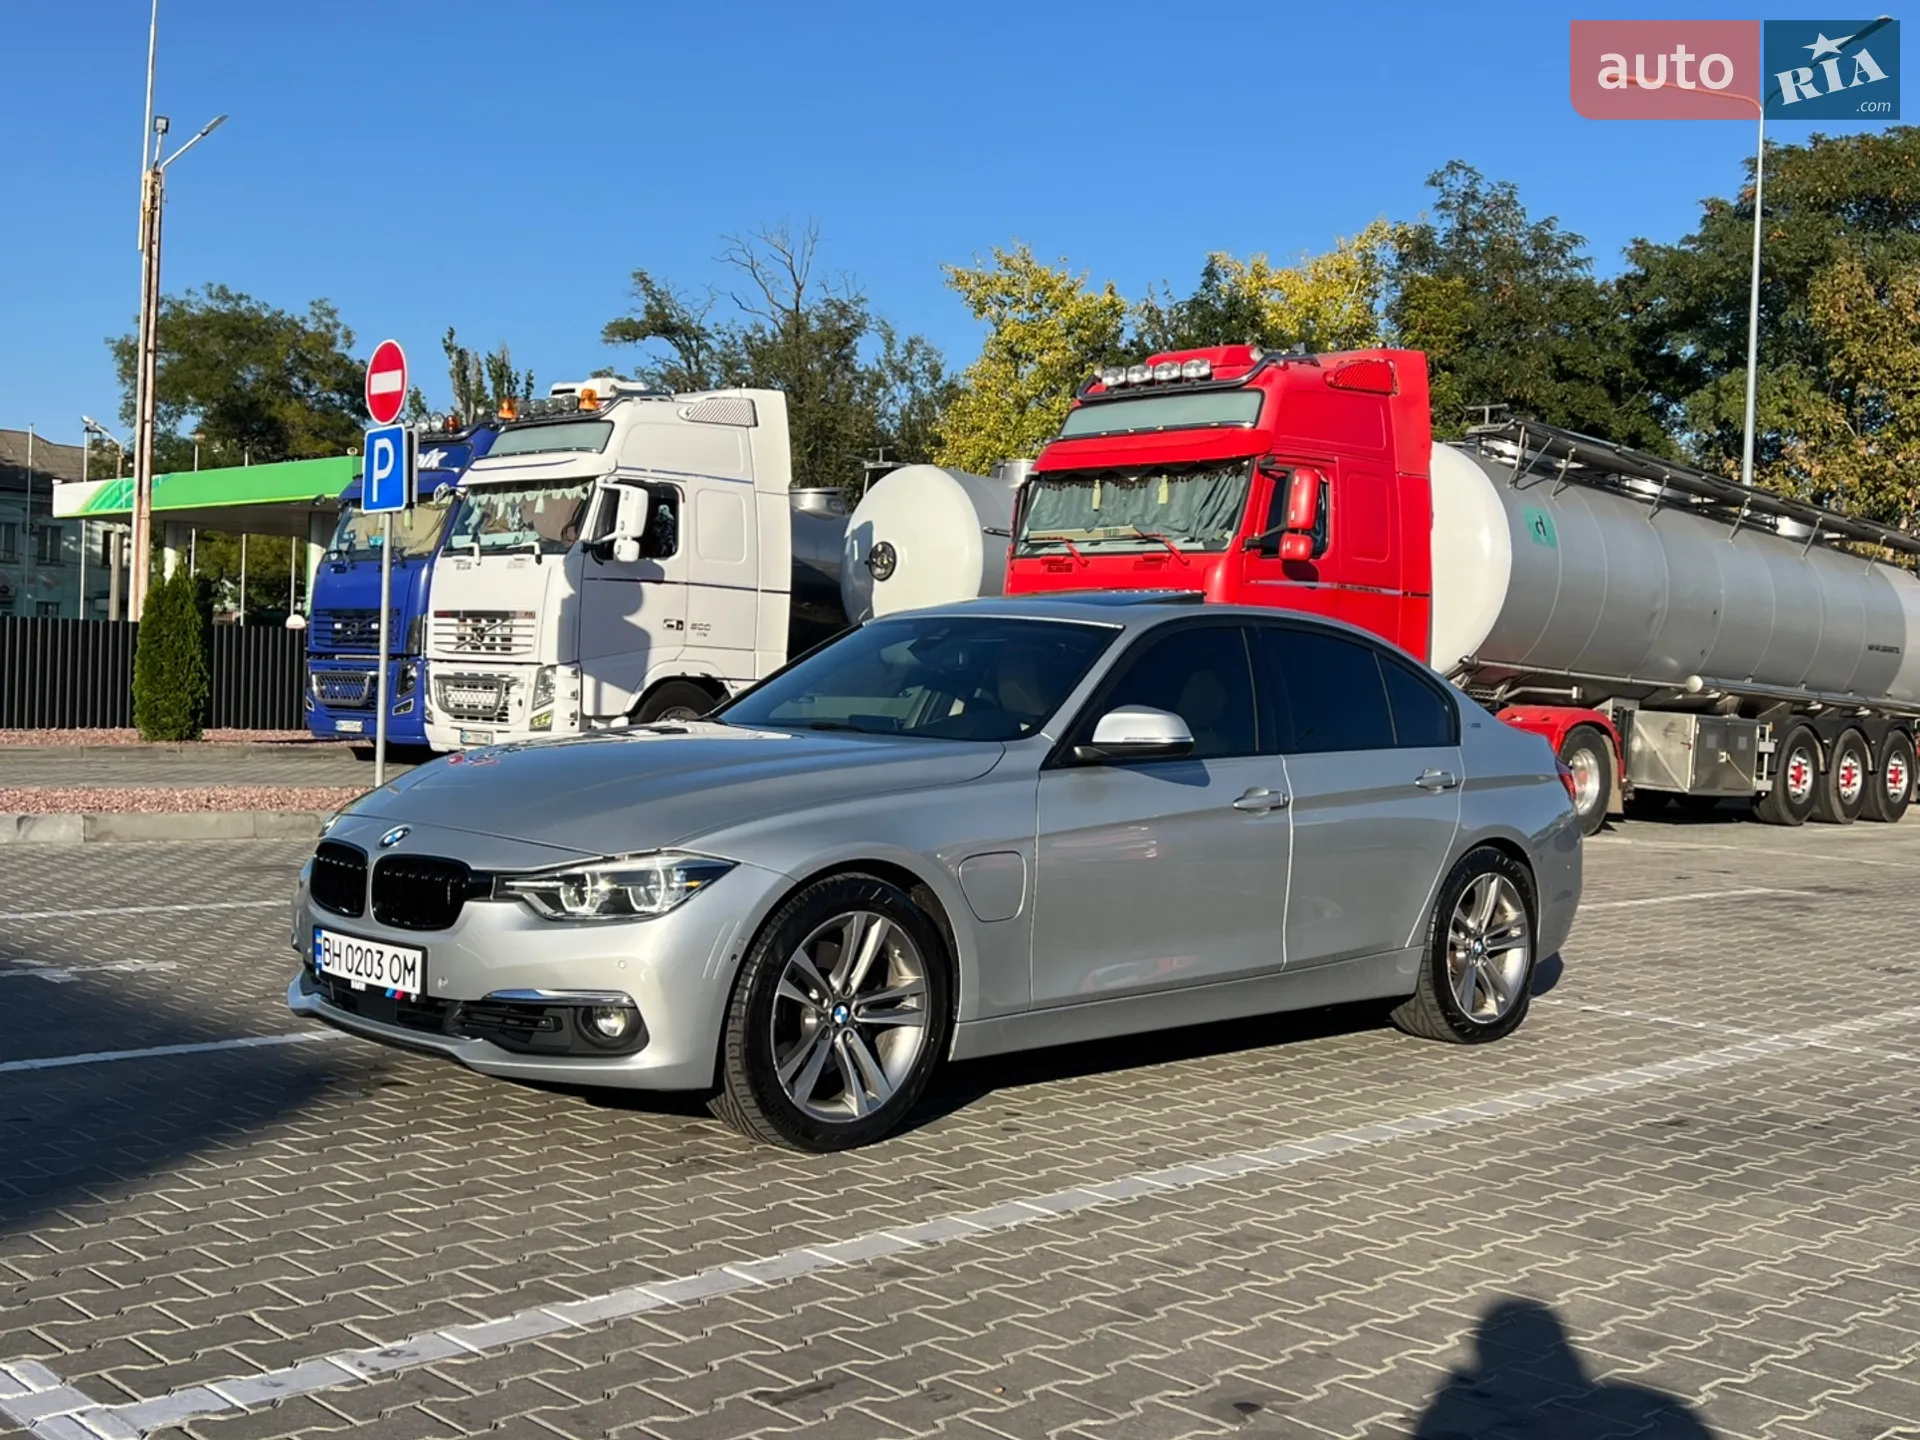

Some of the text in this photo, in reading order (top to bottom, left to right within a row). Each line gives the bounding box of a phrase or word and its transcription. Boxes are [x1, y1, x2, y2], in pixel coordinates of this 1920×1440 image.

[372, 438, 394, 502] P
[323, 937, 416, 988] BH 0203 OM
